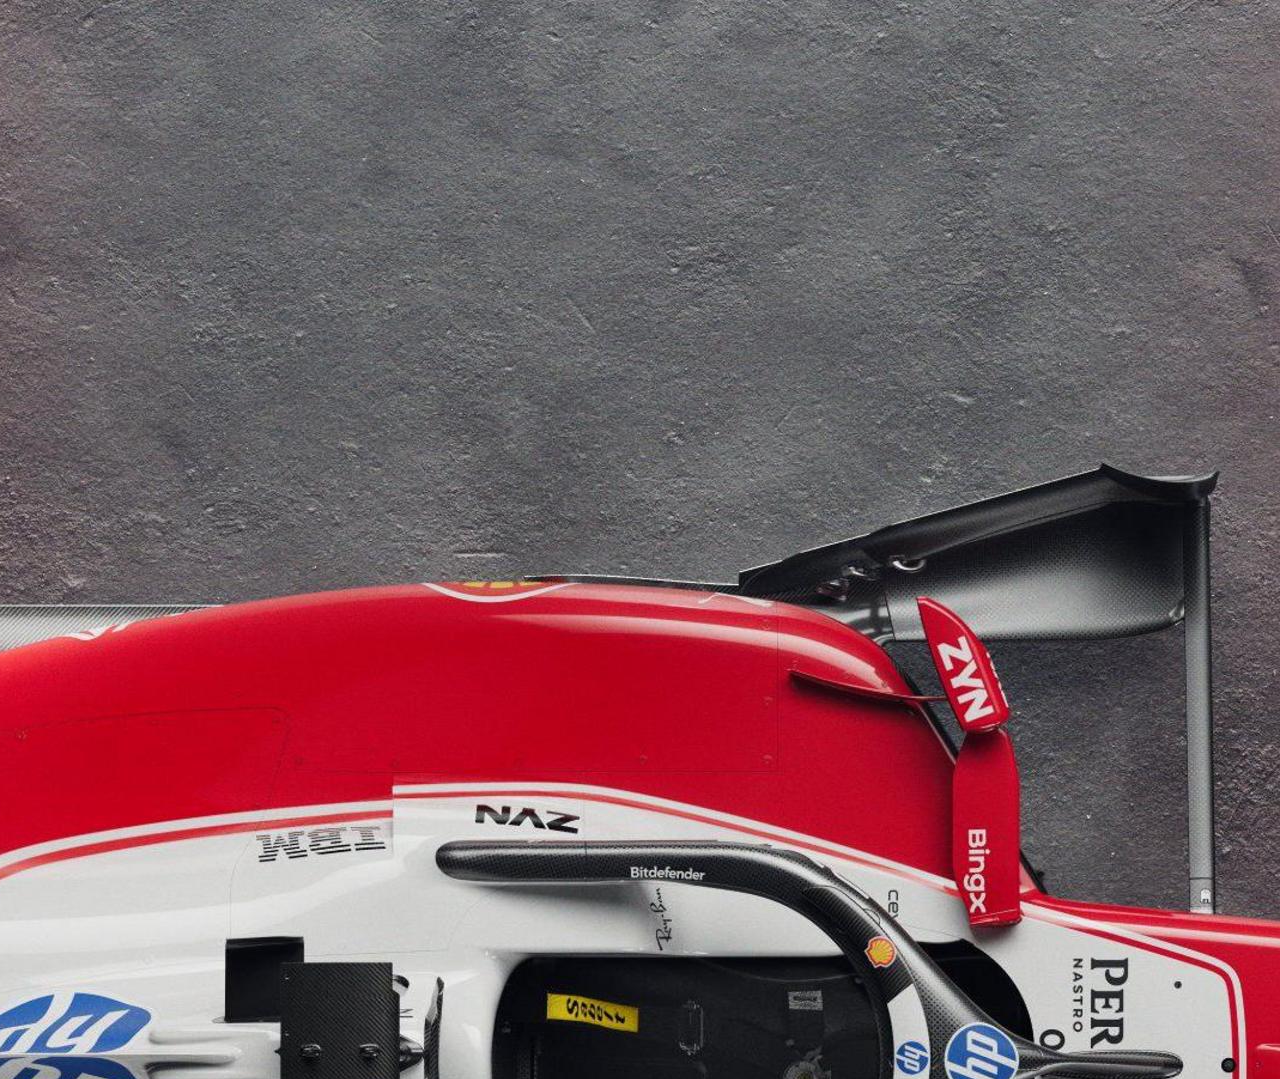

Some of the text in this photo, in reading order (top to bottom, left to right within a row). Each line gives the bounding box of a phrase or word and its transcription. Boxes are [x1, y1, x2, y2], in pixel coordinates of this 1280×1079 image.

[938, 636, 994, 722] ZYN
[475, 804, 580, 834] ZYN
[256, 826, 386, 863] IBM
[630, 865, 705, 882] Bitdefender
[1072, 958, 1083, 1033] NASTRO
[896, 1044, 929, 1072] hp
